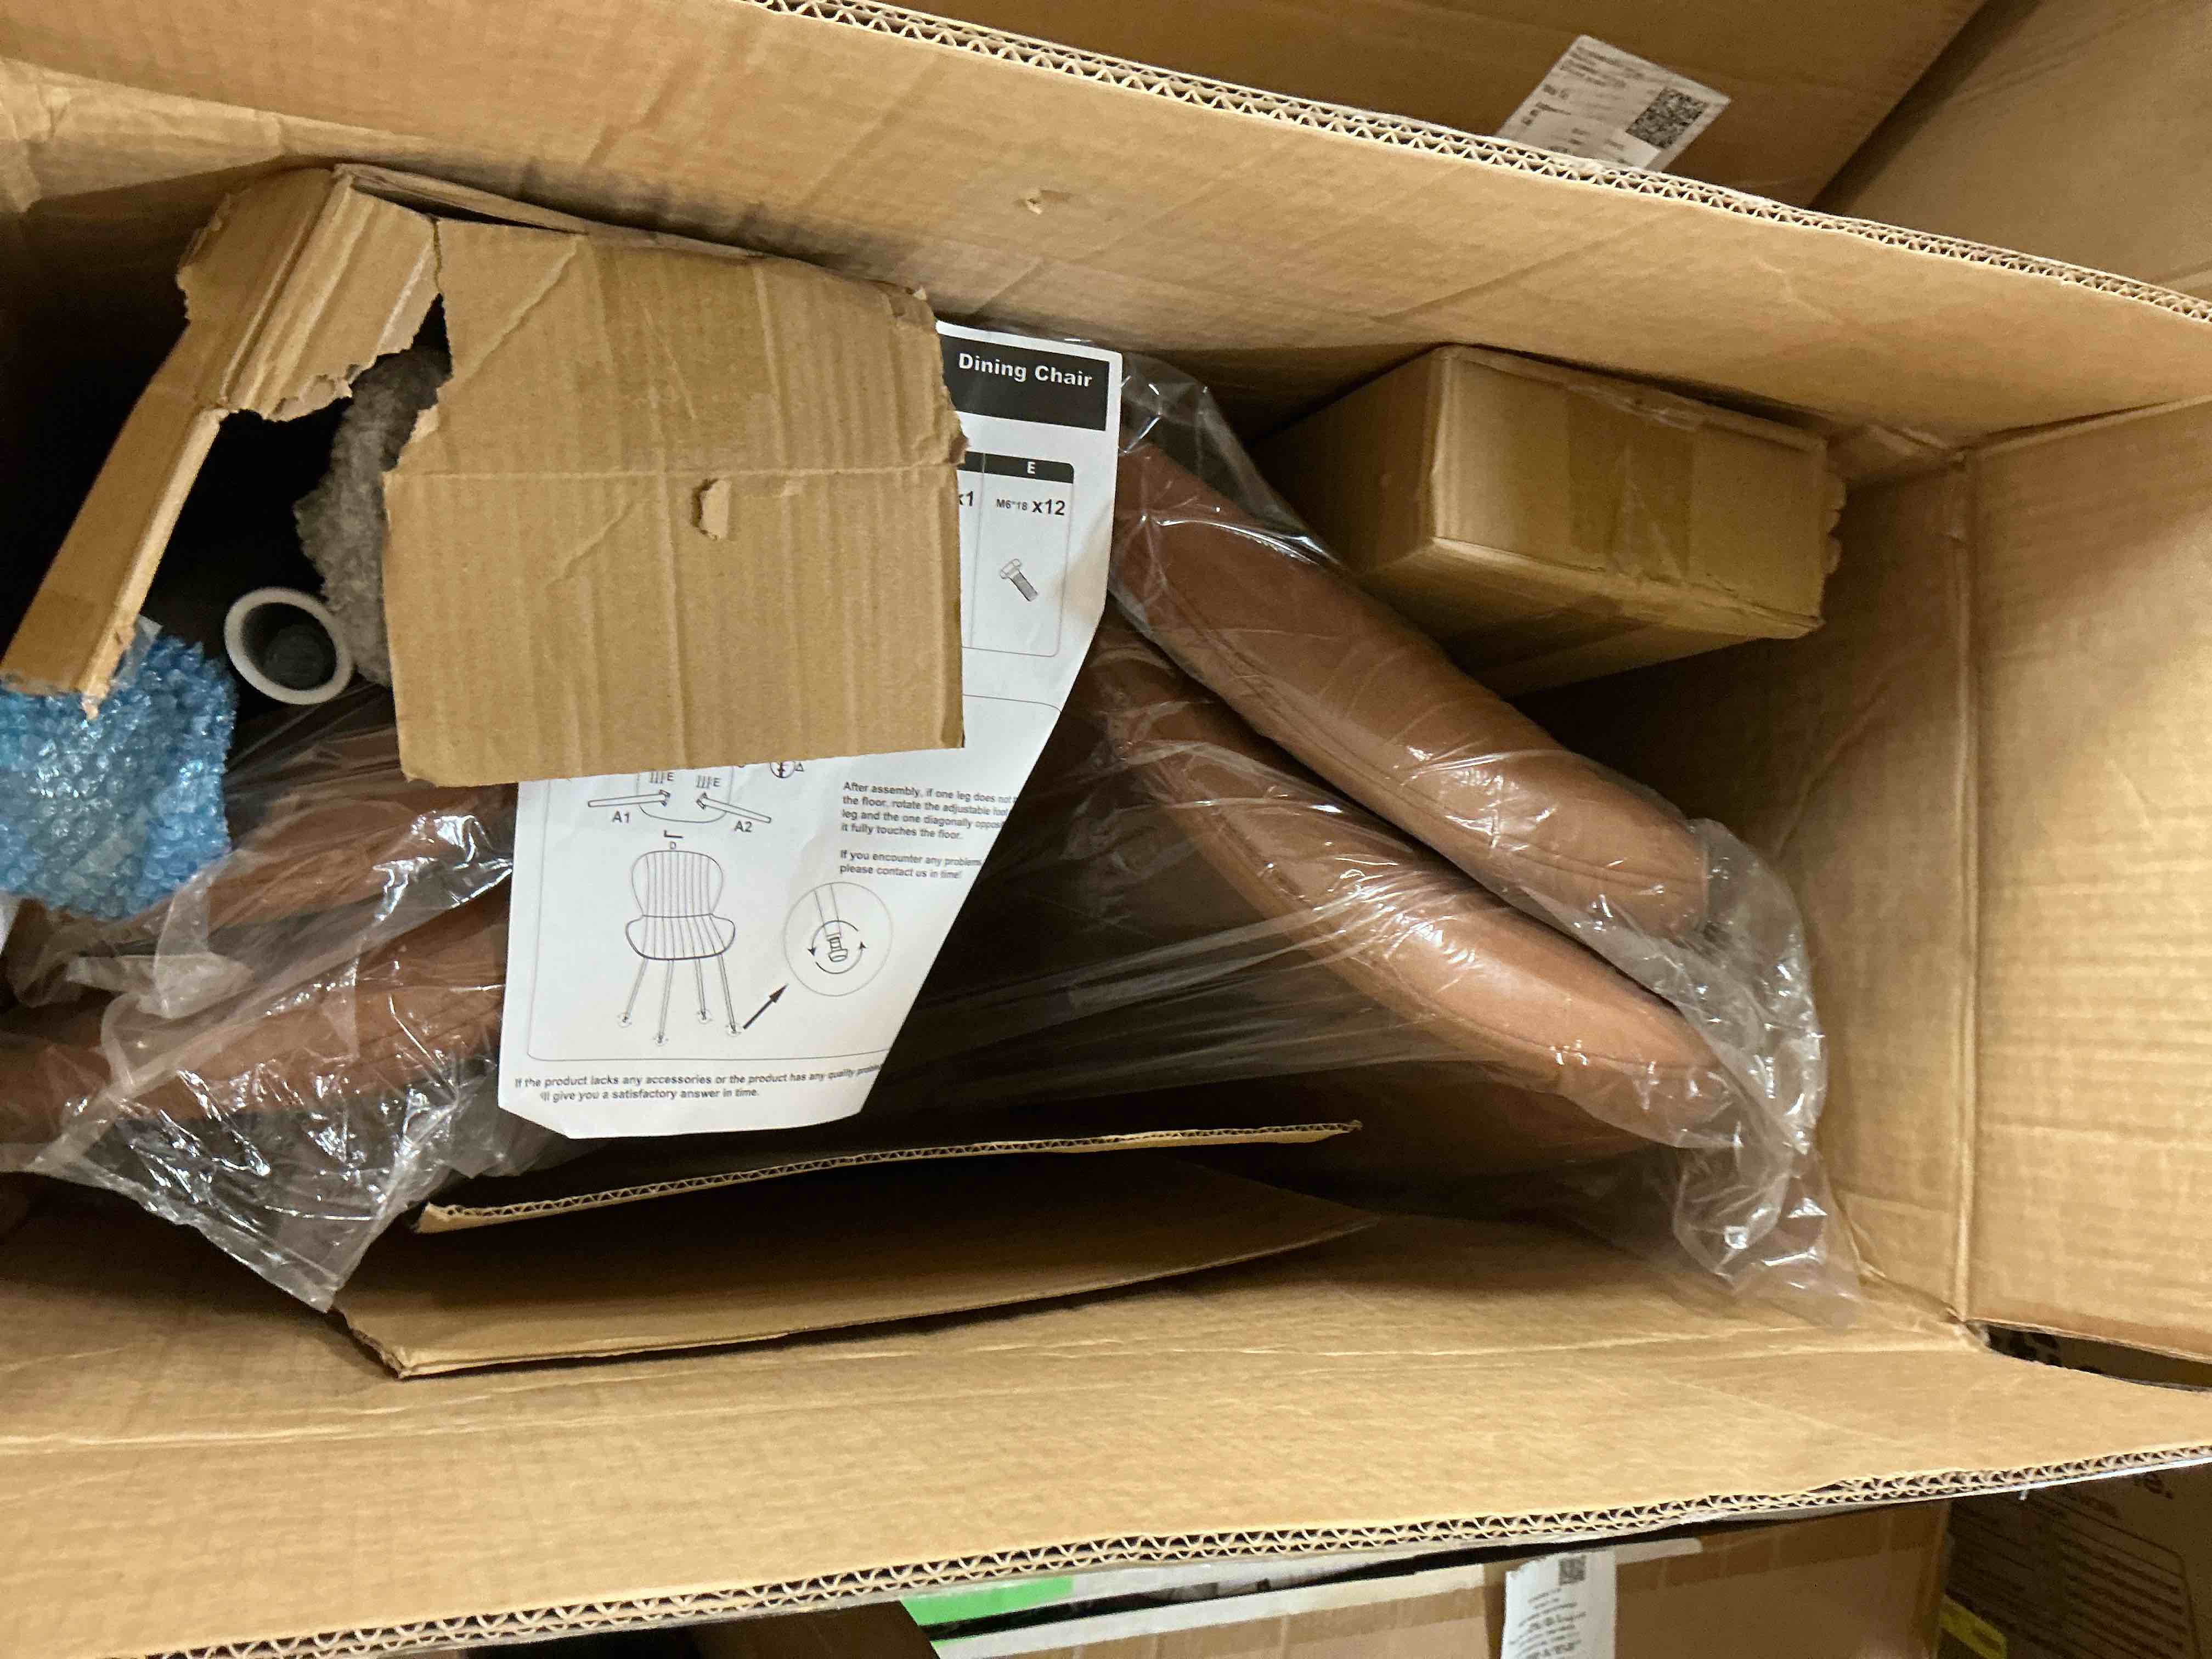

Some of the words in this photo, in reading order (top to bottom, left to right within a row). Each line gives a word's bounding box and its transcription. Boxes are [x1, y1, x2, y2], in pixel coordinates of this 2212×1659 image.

[958, 353, 1027, 382] Dining
[1035, 365, 1093, 387] Chair
[1027, 461, 1036, 474] E
[1032, 500, 1066, 516] x12
[843, 781, 868, 792] After
[926, 788, 933, 797] if
[935, 791, 953, 799] one
[957, 791, 970, 802] leg
[974, 792, 996, 803] does
[843, 795, 859, 805] the
[893, 800, 921, 809] rotate
[924, 802, 940, 811] the
[944, 804, 990, 816] adjustable
[612, 810, 630, 823] A1
[842, 809, 857, 820] leg
[861, 811, 880, 820] and
[883, 812, 900, 821] the
[903, 815, 921, 823] one
[924, 815, 970, 829] diagonally
[734, 821, 752, 832] A2
[842, 822, 848, 831] it
[851, 823, 873, 835] fully
[877, 825, 918, 836] touches
[920, 828, 935, 837] the
[670, 842, 676, 850] D
[840, 849, 847, 859] If
[850, 851, 869, 861] you
[873, 853, 923, 864] encounter
[926, 856, 941, 866] any
[840, 864, 873, 874] please
[877, 866, 913, 876] contact
[515, 1077, 522, 1087] If
[525, 1077, 541, 1087] the
[544, 1075, 588, 1088] product
[591, 1075, 618, 1085] lacks
[623, 1076, 641, 1086] any
[646, 1074, 712, 1084] accessories
[715, 1076, 726, 1084] or
[730, 1074, 746, 1084] the
[748, 1073, 787, 1085] product
[791, 1073, 806, 1081] has
[809, 1073, 825, 1081] any
[553, 1091, 575, 1103] give
[578, 1091, 600, 1102] you
[602, 1091, 609, 1099] a
[612, 1088, 676, 1100] satisfactory
[681, 1090, 720, 1098] answer
[723, 1088, 732, 1097] in
